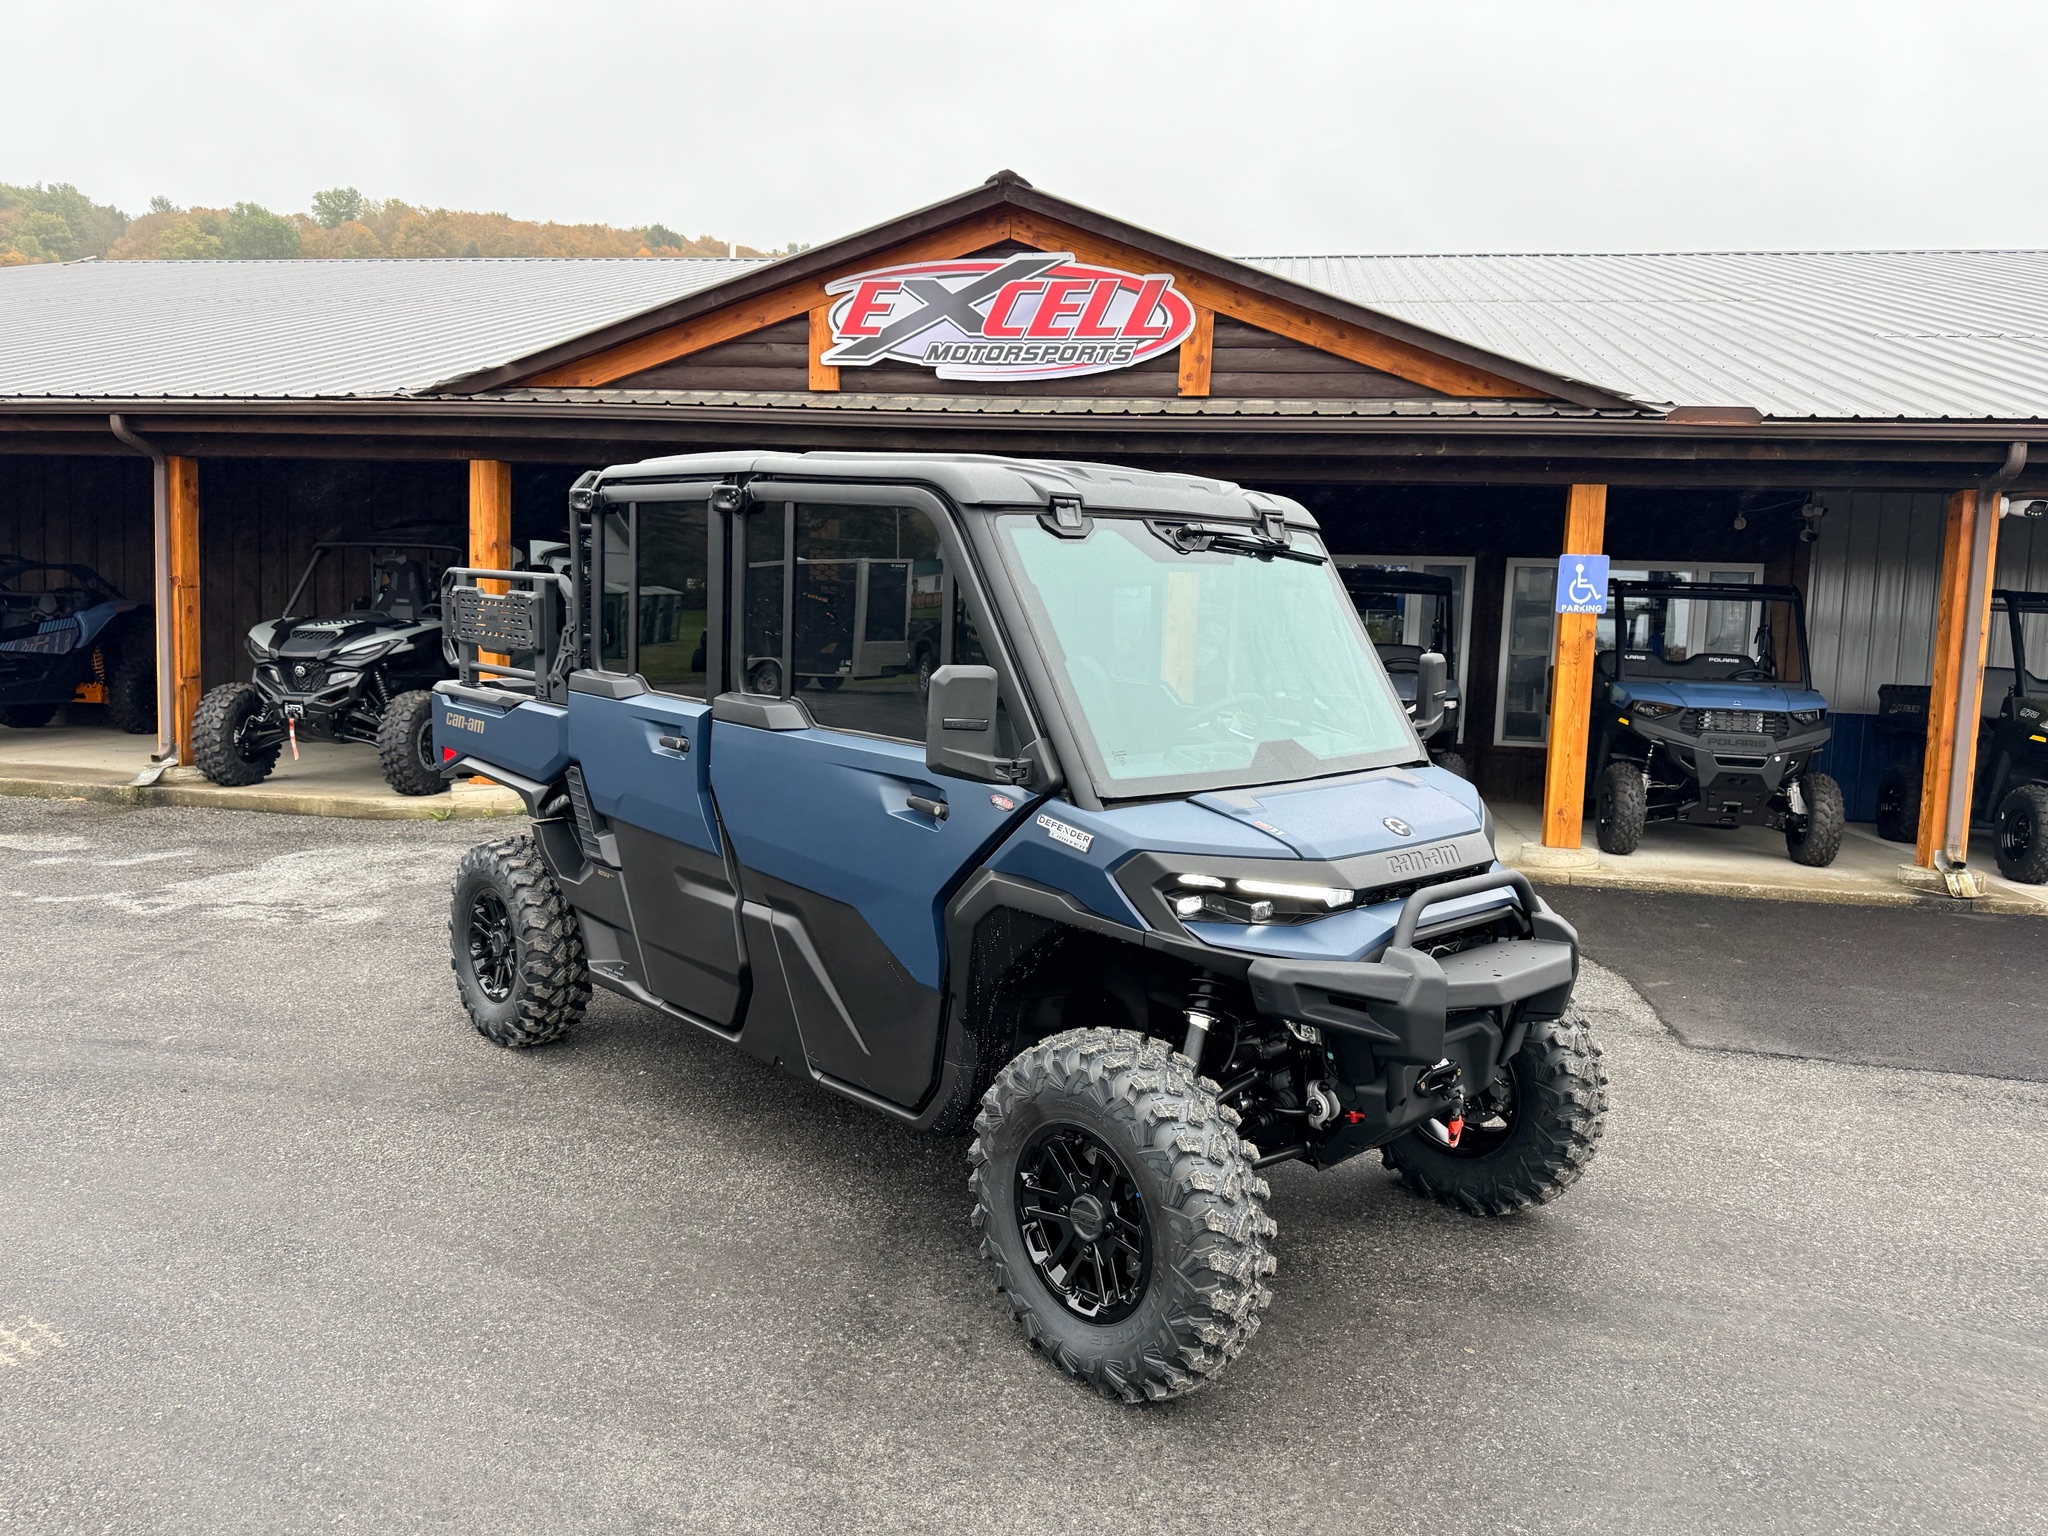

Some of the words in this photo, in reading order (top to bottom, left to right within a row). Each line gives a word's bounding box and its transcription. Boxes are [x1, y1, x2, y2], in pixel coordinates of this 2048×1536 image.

[833, 259, 1174, 358] EXCELL
[923, 341, 1137, 365] MOTORSPORTS
[1561, 604, 1603, 612] PARKING
[446, 712, 485, 734] can-am
[1707, 738, 1767, 748] POLARIS
[1038, 816, 1090, 844] DEFENDER
[1386, 843, 1462, 876] can-am
